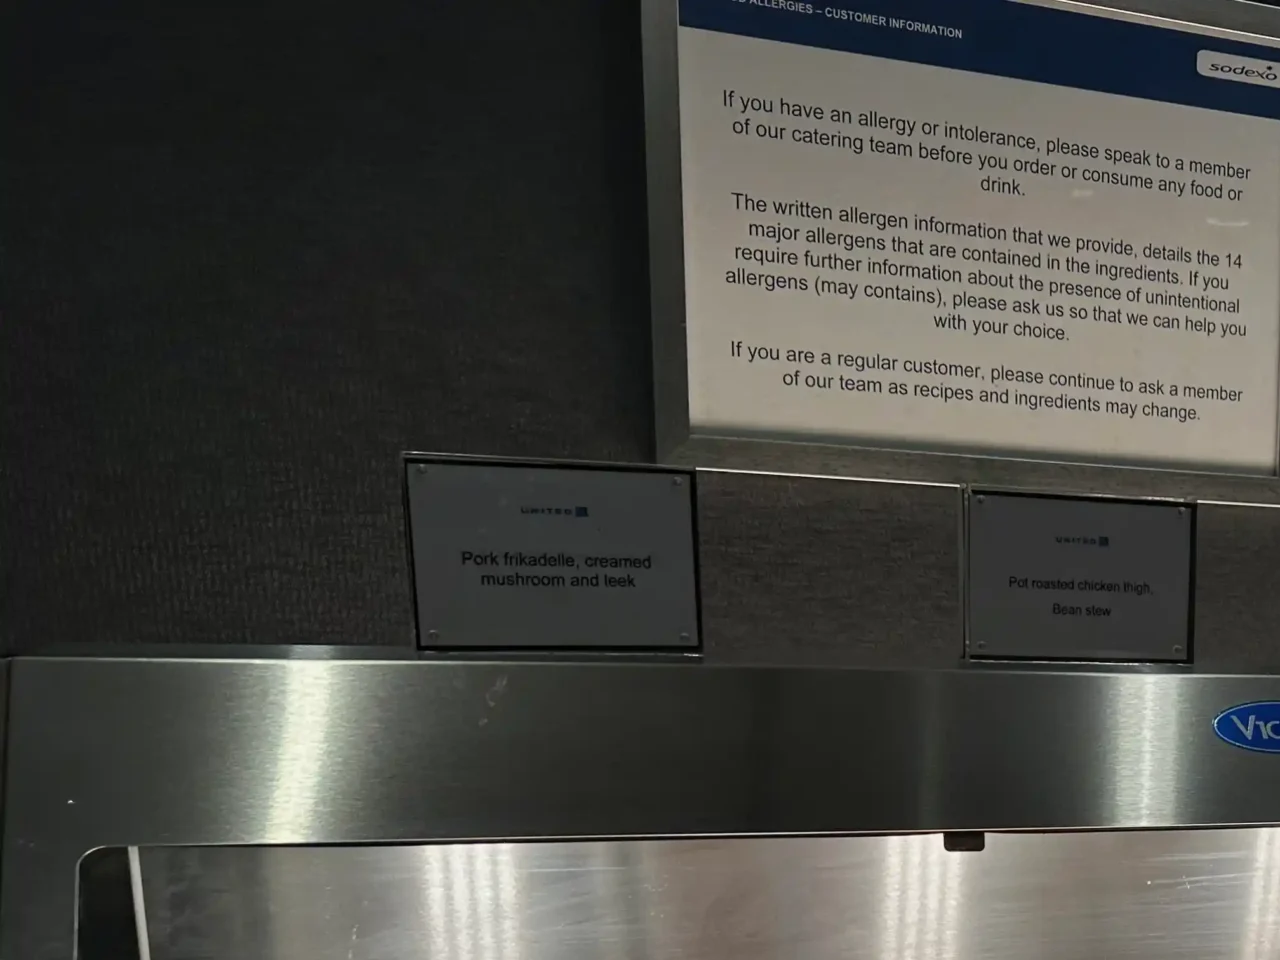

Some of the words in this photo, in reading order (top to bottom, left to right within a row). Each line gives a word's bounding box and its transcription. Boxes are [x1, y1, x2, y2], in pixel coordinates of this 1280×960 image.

[825, 7, 887, 27] CUSTOMER
[889, 18, 963, 39] INFORMATION
[1209, 63, 1278, 81] sodexo
[723, 89, 735, 108] If
[739, 96, 773, 114] you
[780, 97, 824, 120] have
[830, 109, 852, 124] an
[858, 110, 917, 136] allergy
[921, 122, 940, 136] or
[944, 121, 1040, 153] intolerance,
[1046, 137, 1099, 159] please
[1104, 148, 1151, 167] speak
[1155, 152, 1170, 169] to
[1175, 158, 1184, 171] a
[1189, 160, 1251, 180] member
[732, 118, 751, 135] of
[755, 124, 787, 140] our
[791, 128, 864, 155] catering
[869, 135, 913, 158] team
[919, 141, 973, 165] before
[977, 154, 1008, 171] you
[1013, 158, 1057, 176] order
[1061, 165, 1078, 179] or
[1082, 168, 1153, 190] consume
[1158, 179, 1186, 197] any
[1190, 179, 1223, 199] food
[1227, 188, 1243, 201] or
[980, 175, 1025, 196] drink.
[731, 192, 767, 213] The
[772, 199, 833, 221] written
[838, 206, 908, 231] allergen
[914, 214, 1007, 241] information
[1012, 226, 1043, 246] that
[1047, 234, 1071, 249] we
[1076, 237, 1138, 259] provide,
[1142, 243, 1192, 264] details
[1197, 249, 1220, 267] the
[1225, 253, 1242, 269] 14
[749, 222, 800, 244] major
[805, 226, 886, 252] allergens
[891, 236, 924, 256] that
[929, 244, 957, 259] are
[962, 247, 1041, 269] contained
[1047, 253, 1060, 271] in
[1065, 256, 1090, 274] the
[1095, 259, 1183, 285] ingredients.
[1189, 270, 1199, 287] If
[1202, 276, 1229, 292] you
[735, 246, 799, 266] require
[803, 249, 863, 272] further
[868, 256, 962, 283] information
[967, 269, 1014, 289] about
[1018, 274, 1044, 292] the
[1049, 281, 1122, 301] presence
[1126, 286, 1142, 303] of
[1145, 289, 1240, 314] unintentional
[725, 267, 809, 292] allergens
[814, 275, 859, 300] (may
[864, 284, 947, 308] contains),
[952, 291, 1007, 311] please
[1012, 298, 1041, 315] ask
[1046, 304, 1064, 317] us
[1069, 306, 1088, 320] so
[1092, 305, 1122, 324] that
[1126, 312, 1148, 326] we
[1153, 315, 1180, 330] can
[1185, 315, 1216, 337] help
[1220, 323, 1246, 338] you
[933, 312, 967, 331] with
[972, 319, 1009, 336] your
[1013, 320, 1069, 341] choice.
[731, 340, 743, 357] If
[747, 346, 780, 363] you
[786, 349, 815, 364] are
[820, 352, 832, 366] a
[837, 353, 899, 372] regular
[903, 359, 985, 381] customer,
[991, 364, 1044, 384] please
[1048, 373, 1115, 391] continue
[1119, 376, 1134, 392] to
[1138, 379, 1165, 395] ask
[1169, 384, 1178, 397] a
[1183, 385, 1243, 402] member
[782, 369, 801, 386] of
[805, 375, 834, 389] our
[839, 374, 882, 393] team
[888, 382, 908, 396] as
[914, 382, 974, 403] recipes
[979, 388, 1009, 404] and
[1015, 389, 1101, 412] ingredients
[1106, 401, 1138, 419] may
[1142, 401, 1200, 423] change.
[461, 551, 499, 566] Pork
[503, 552, 580, 569] frikadelle,
[585, 555, 652, 569] creamed
[481, 572, 565, 587] mushroom
[570, 574, 599, 587] and
[604, 574, 636, 588] leek
[1009, 576, 1029, 589] Pot
[1031, 578, 1075, 590] roasted
[1077, 579, 1120, 592] chicken
[1052, 603, 1082, 616] Bean
[1085, 604, 1112, 616] stew
